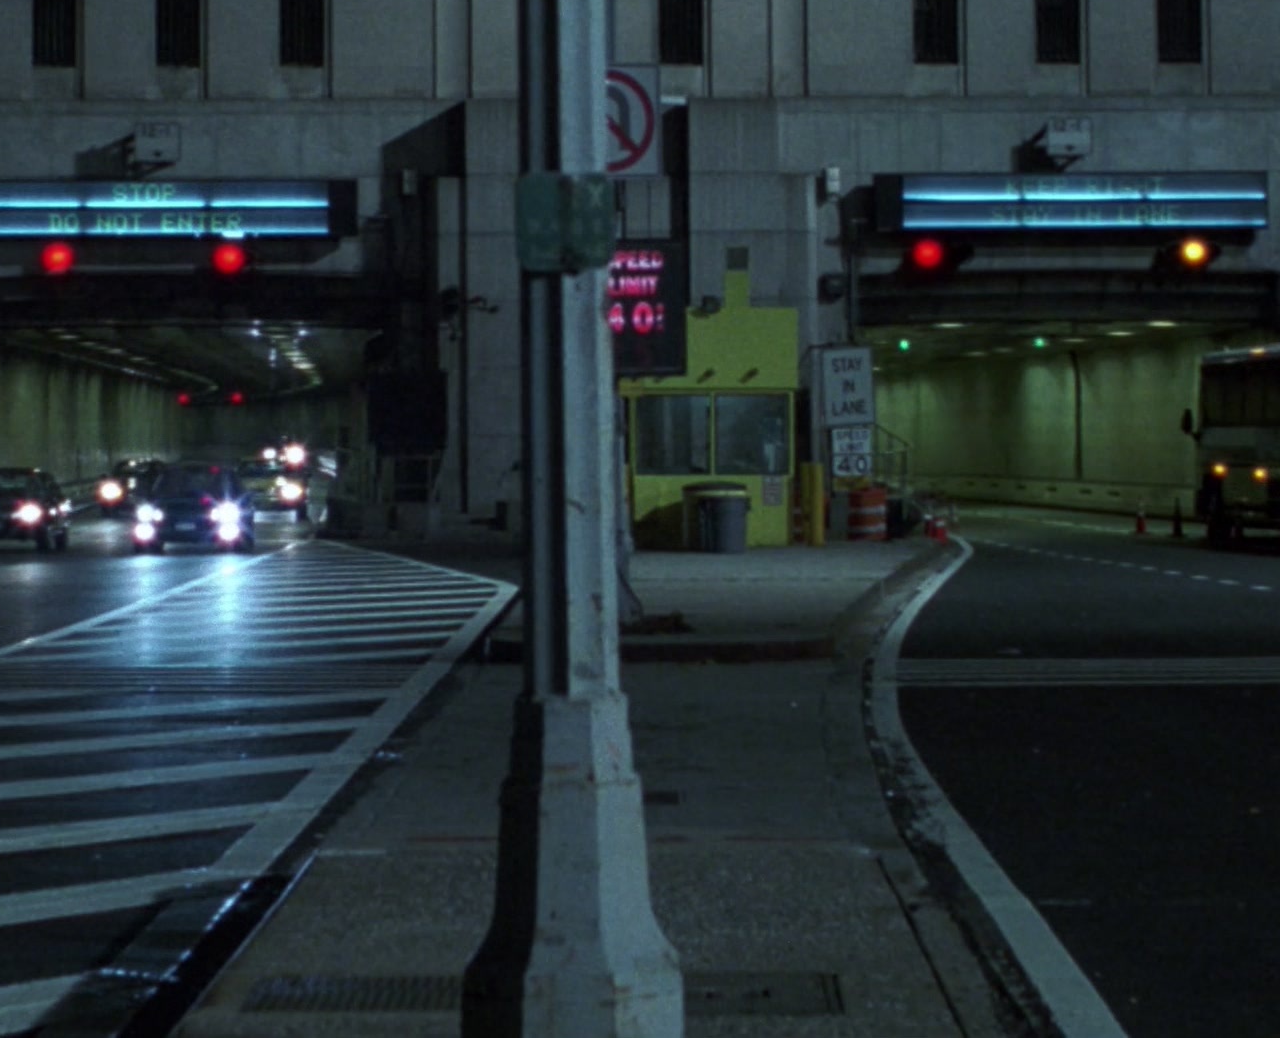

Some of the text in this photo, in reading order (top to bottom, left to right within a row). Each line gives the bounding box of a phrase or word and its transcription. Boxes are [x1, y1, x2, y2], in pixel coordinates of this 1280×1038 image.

[112, 183, 176, 202] STOP
[1005, 176, 1067, 195] KEEP
[48, 213, 242, 232] DO NOT ENTER
[1074, 204, 1102, 223] IN
[1118, 204, 1180, 223] LANE
[831, 357, 862, 372] STAY
[842, 379, 855, 394] IN
[831, 399, 866, 416] LANE
[836, 430, 868, 441] SPEED
[838, 455, 868, 473] 40
